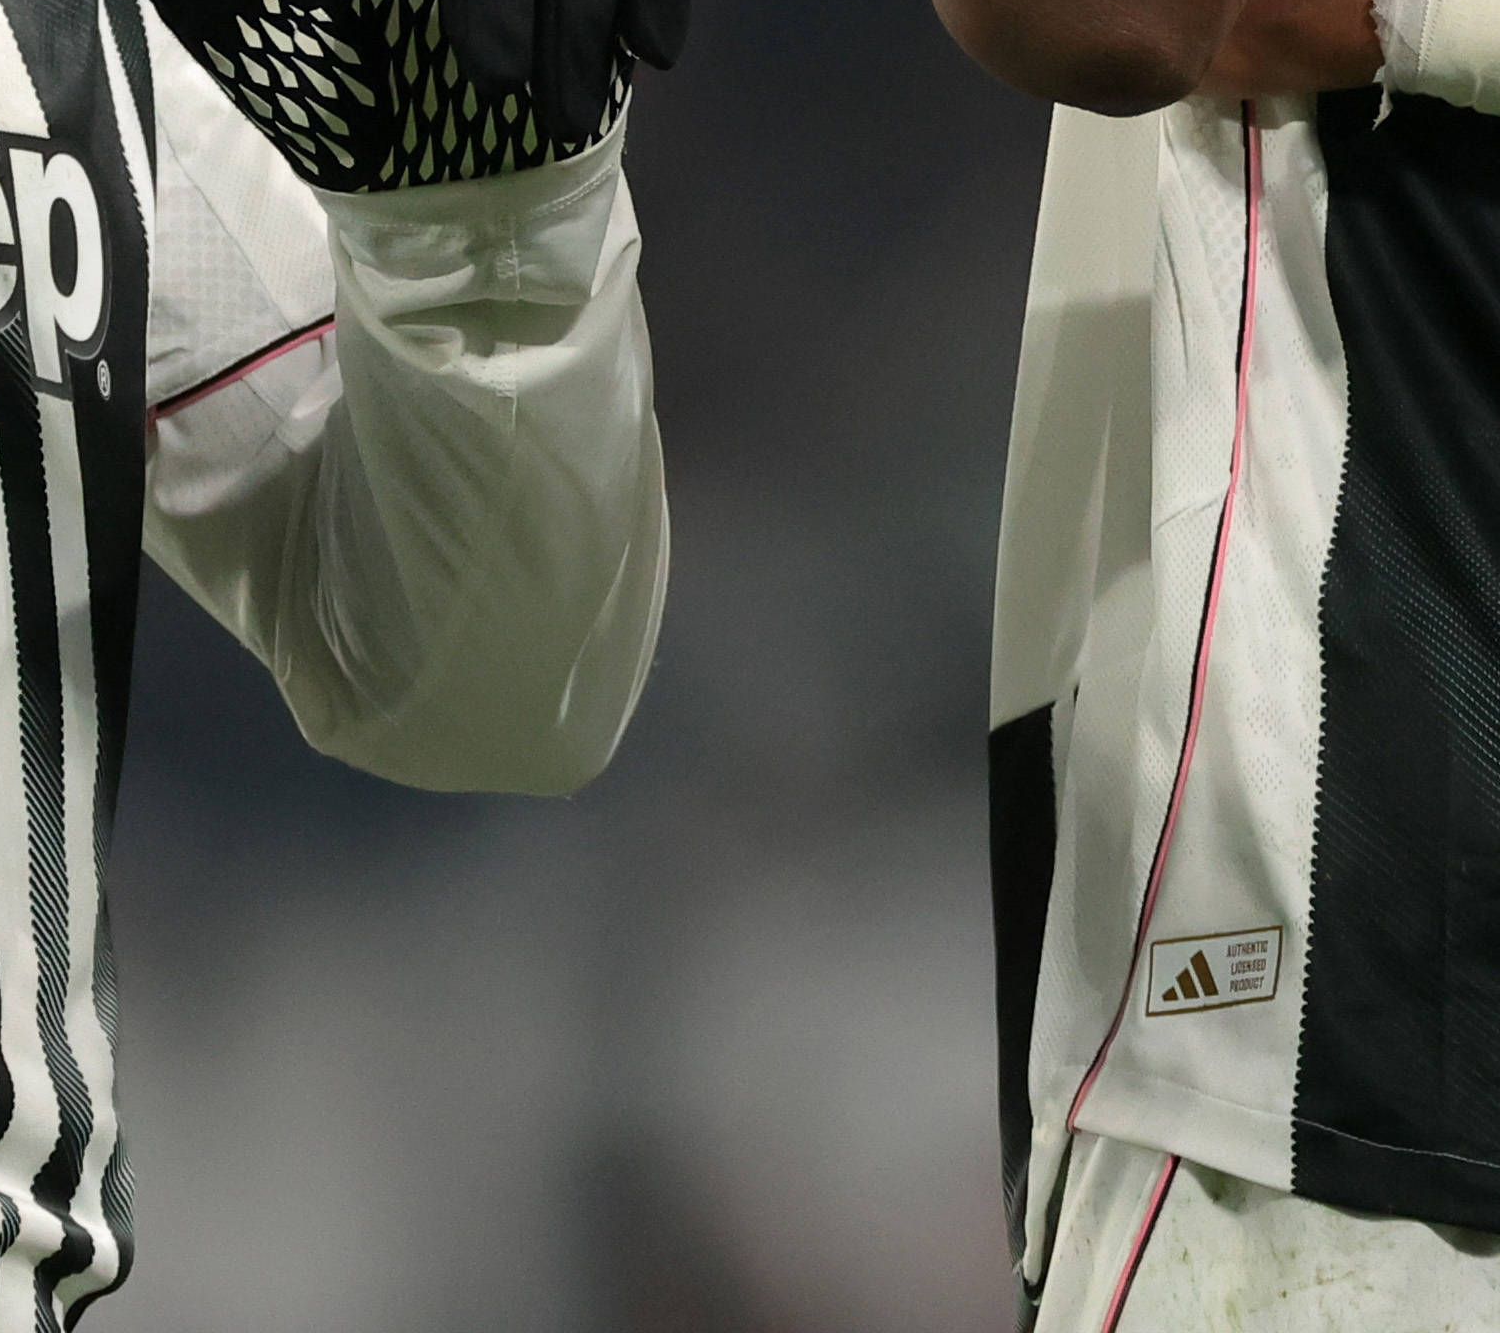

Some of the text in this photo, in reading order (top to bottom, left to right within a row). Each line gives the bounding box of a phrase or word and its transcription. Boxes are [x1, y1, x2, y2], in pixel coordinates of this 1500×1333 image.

[1226, 940, 1268, 958] AUTHENTIC
[1230, 958, 1266, 975] LICENSED
[1229, 976, 1264, 993] PRODUCT
